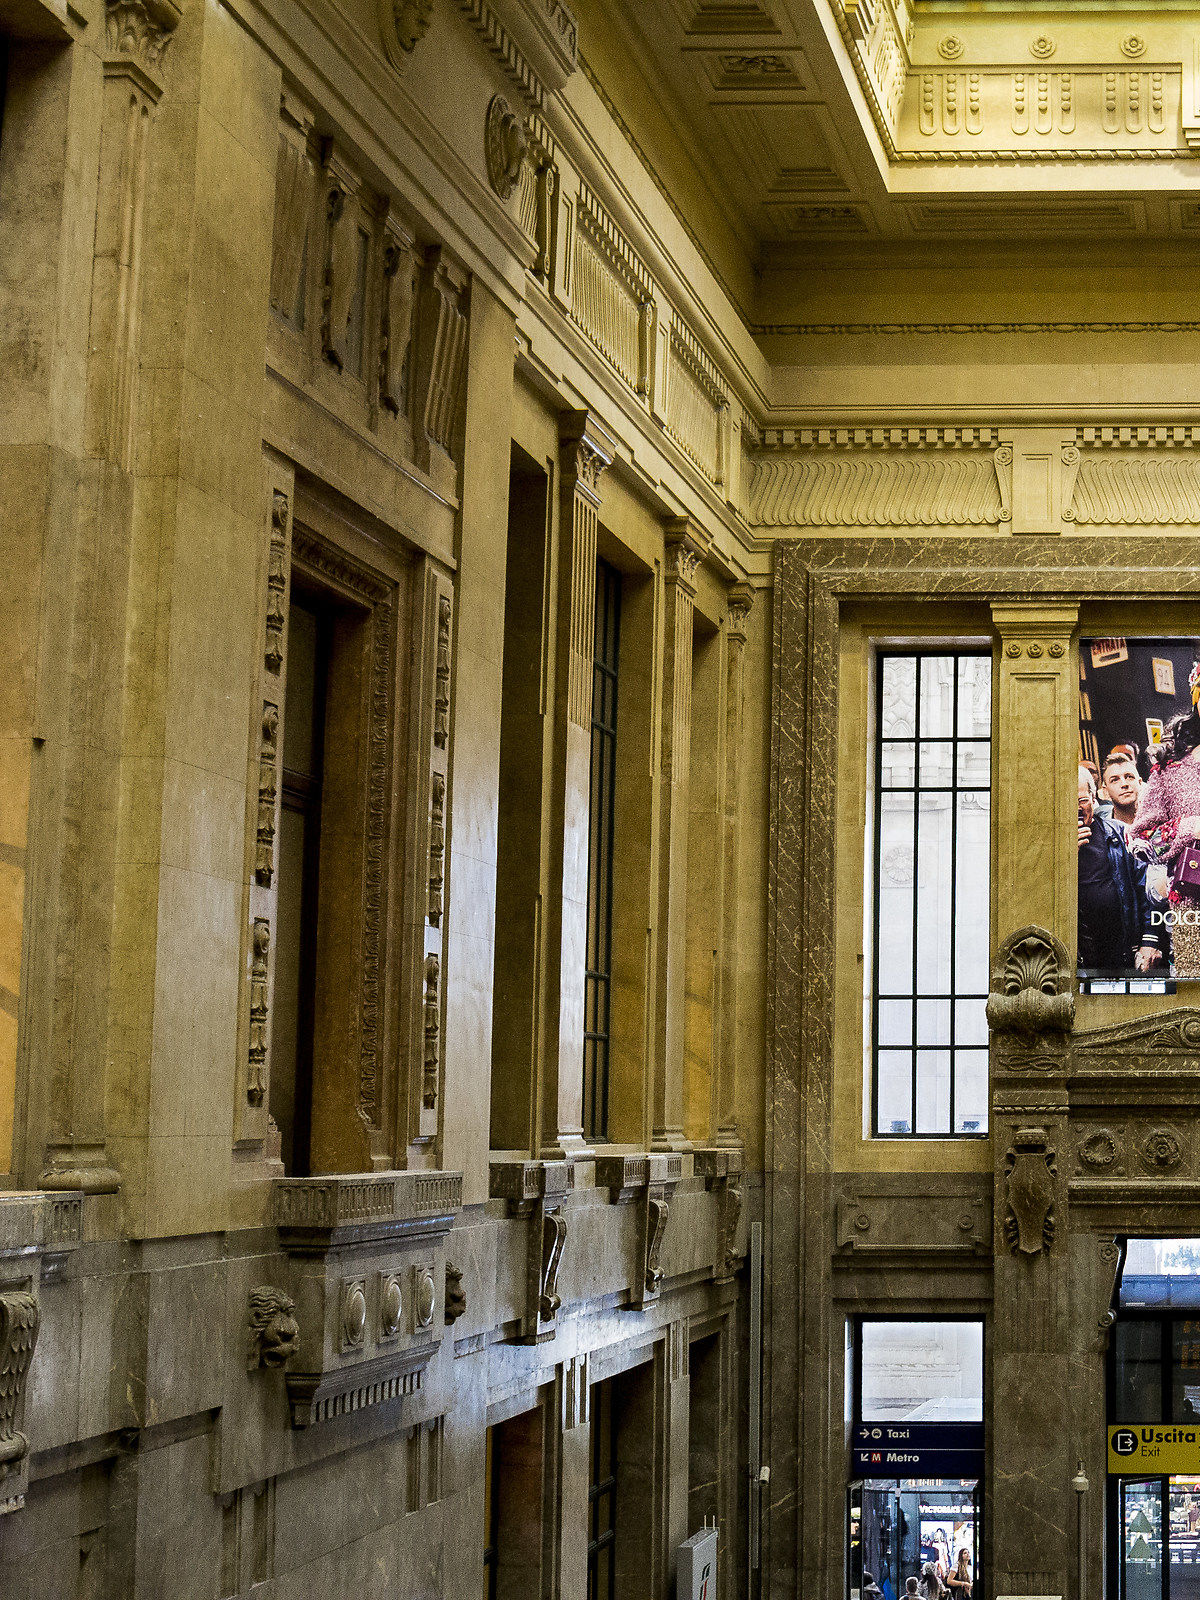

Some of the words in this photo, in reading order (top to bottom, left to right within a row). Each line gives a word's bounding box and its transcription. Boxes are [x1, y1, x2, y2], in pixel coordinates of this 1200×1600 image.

[886, 1429, 910, 1438] Taxi
[1141, 1428, 1196, 1443] Uscita
[1141, 1446, 1161, 1457] Exit
[886, 1453, 920, 1462] Metro
